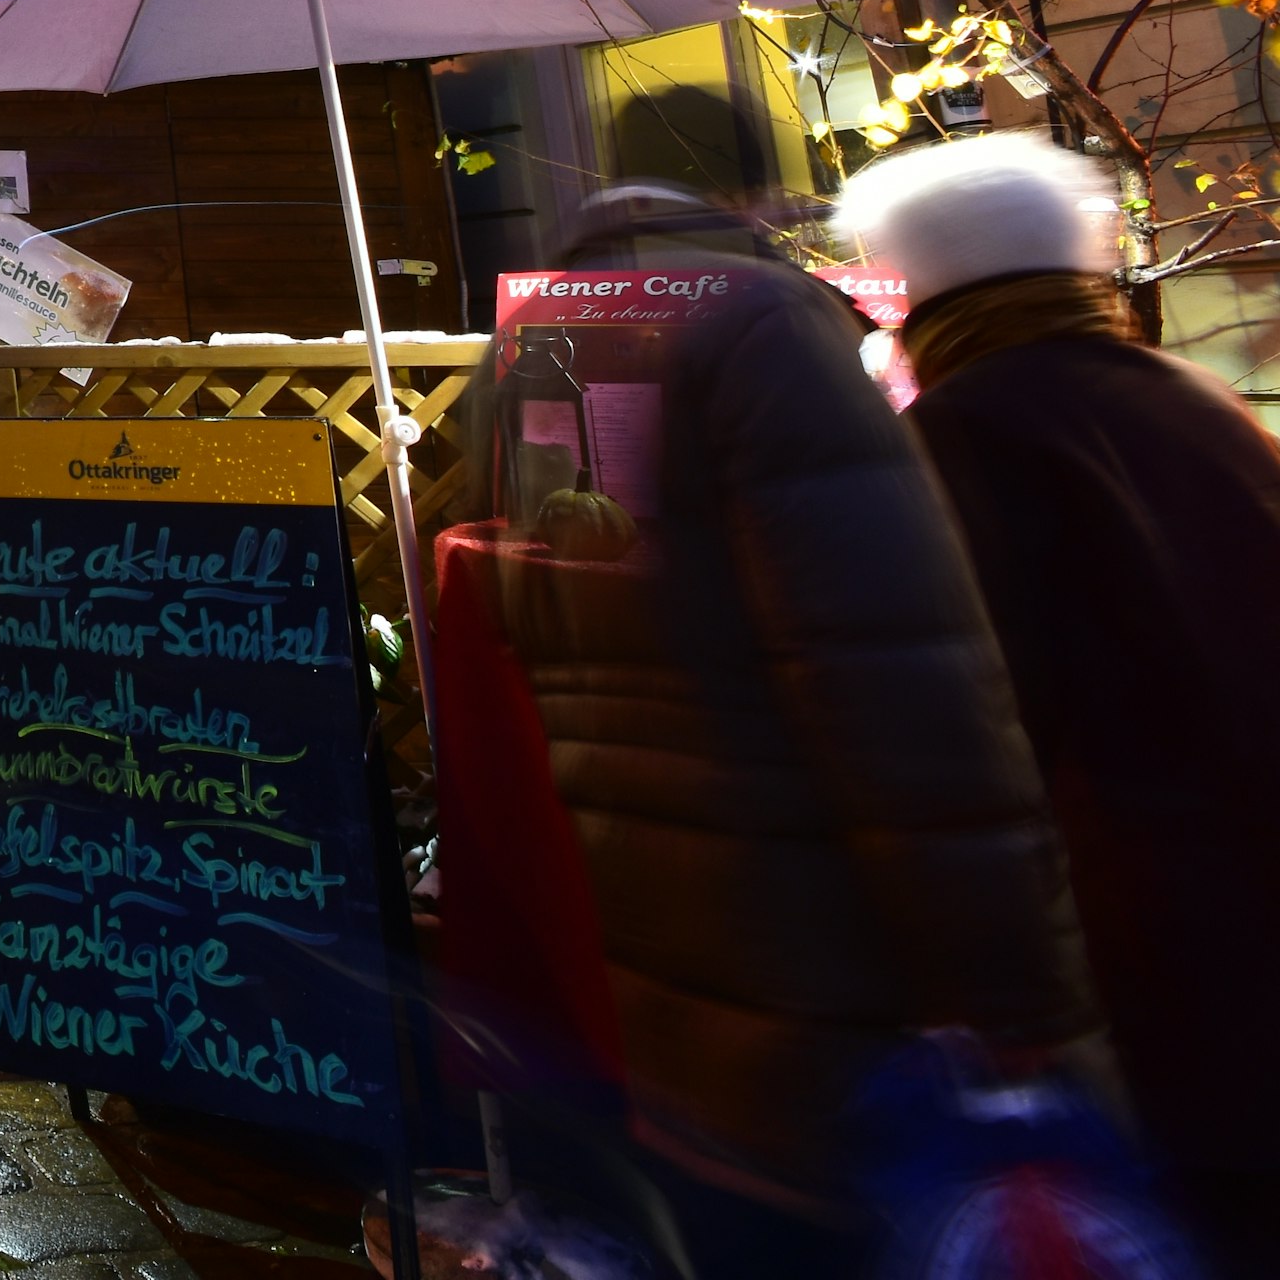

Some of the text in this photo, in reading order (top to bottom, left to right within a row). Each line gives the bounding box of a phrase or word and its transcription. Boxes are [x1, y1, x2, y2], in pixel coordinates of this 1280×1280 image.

[506, 276, 632, 298] Wiener
[643, 273, 729, 301] Café
[611, 305, 676, 321] ebener
[68, 459, 181, 485] Ottakringer
[59, 595, 159, 658] Wiener
[158, 602, 342, 664] Schnitzel
[181, 831, 346, 909] Spinat
[154, 1003, 365, 1107] Küche
